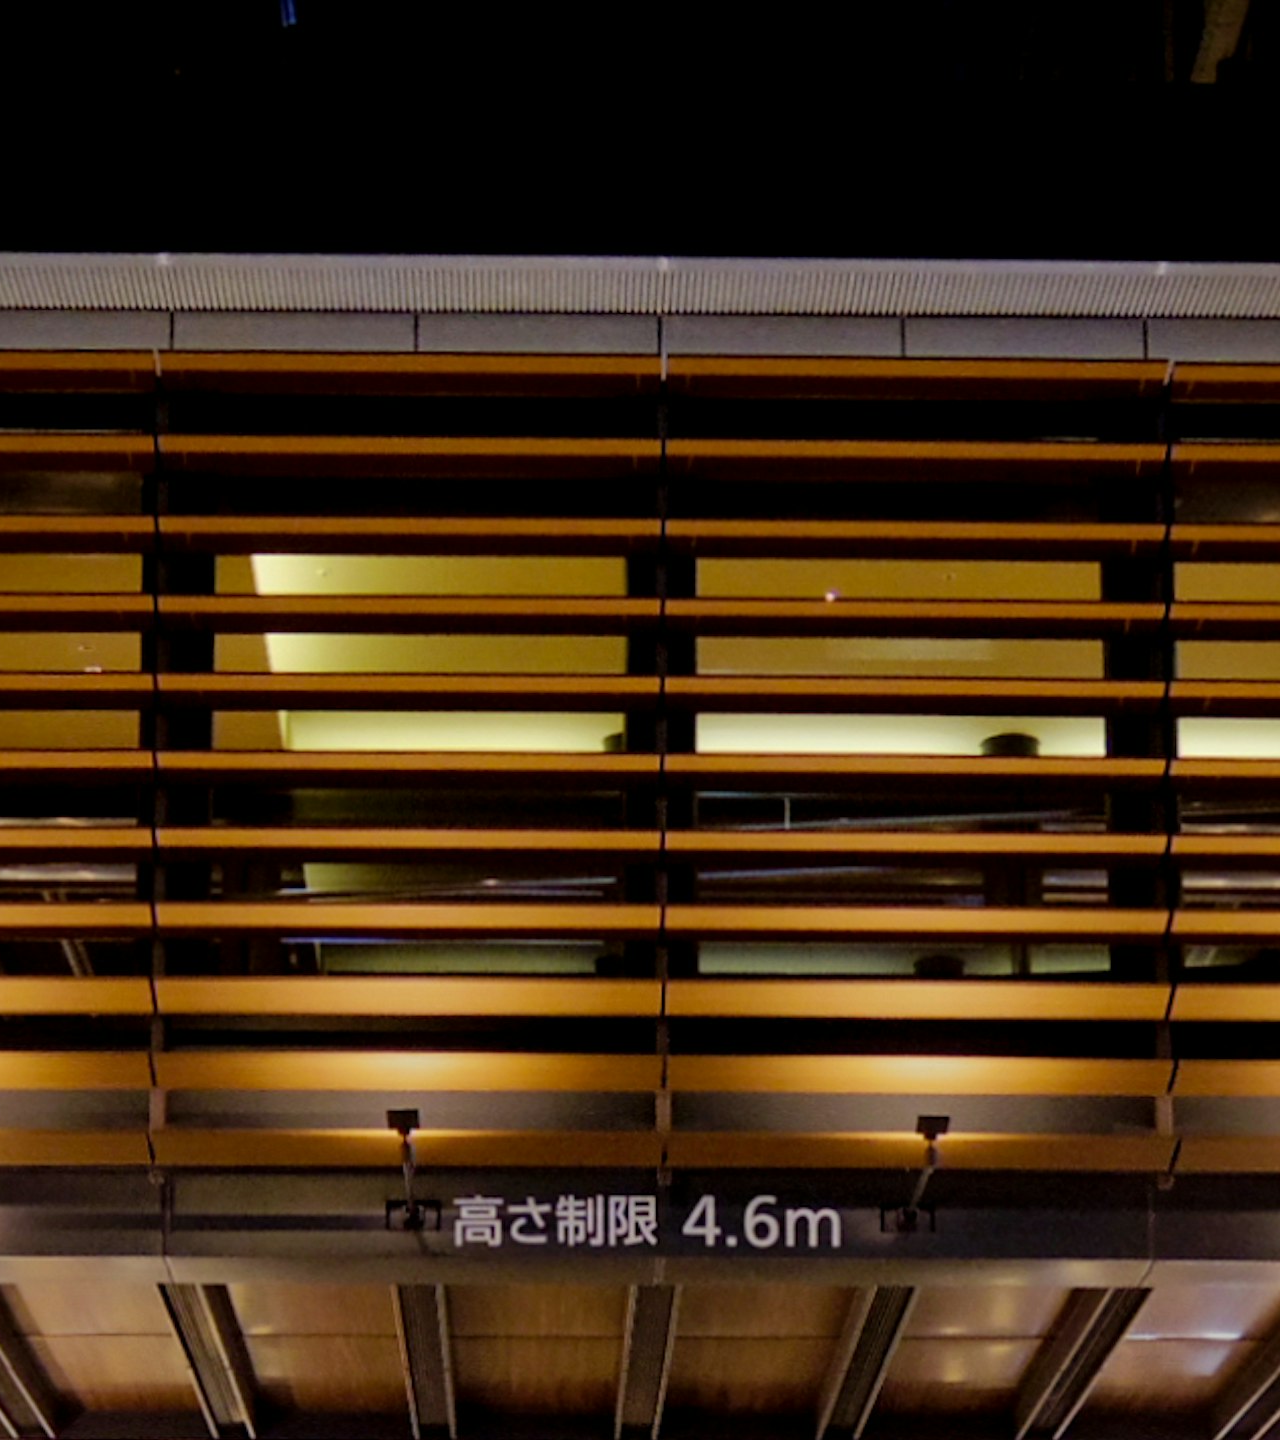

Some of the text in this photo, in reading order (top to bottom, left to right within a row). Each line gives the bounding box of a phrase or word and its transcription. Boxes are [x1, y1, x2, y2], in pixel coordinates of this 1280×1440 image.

[452, 1194, 843, 1249] 高さ制限 4.6m
